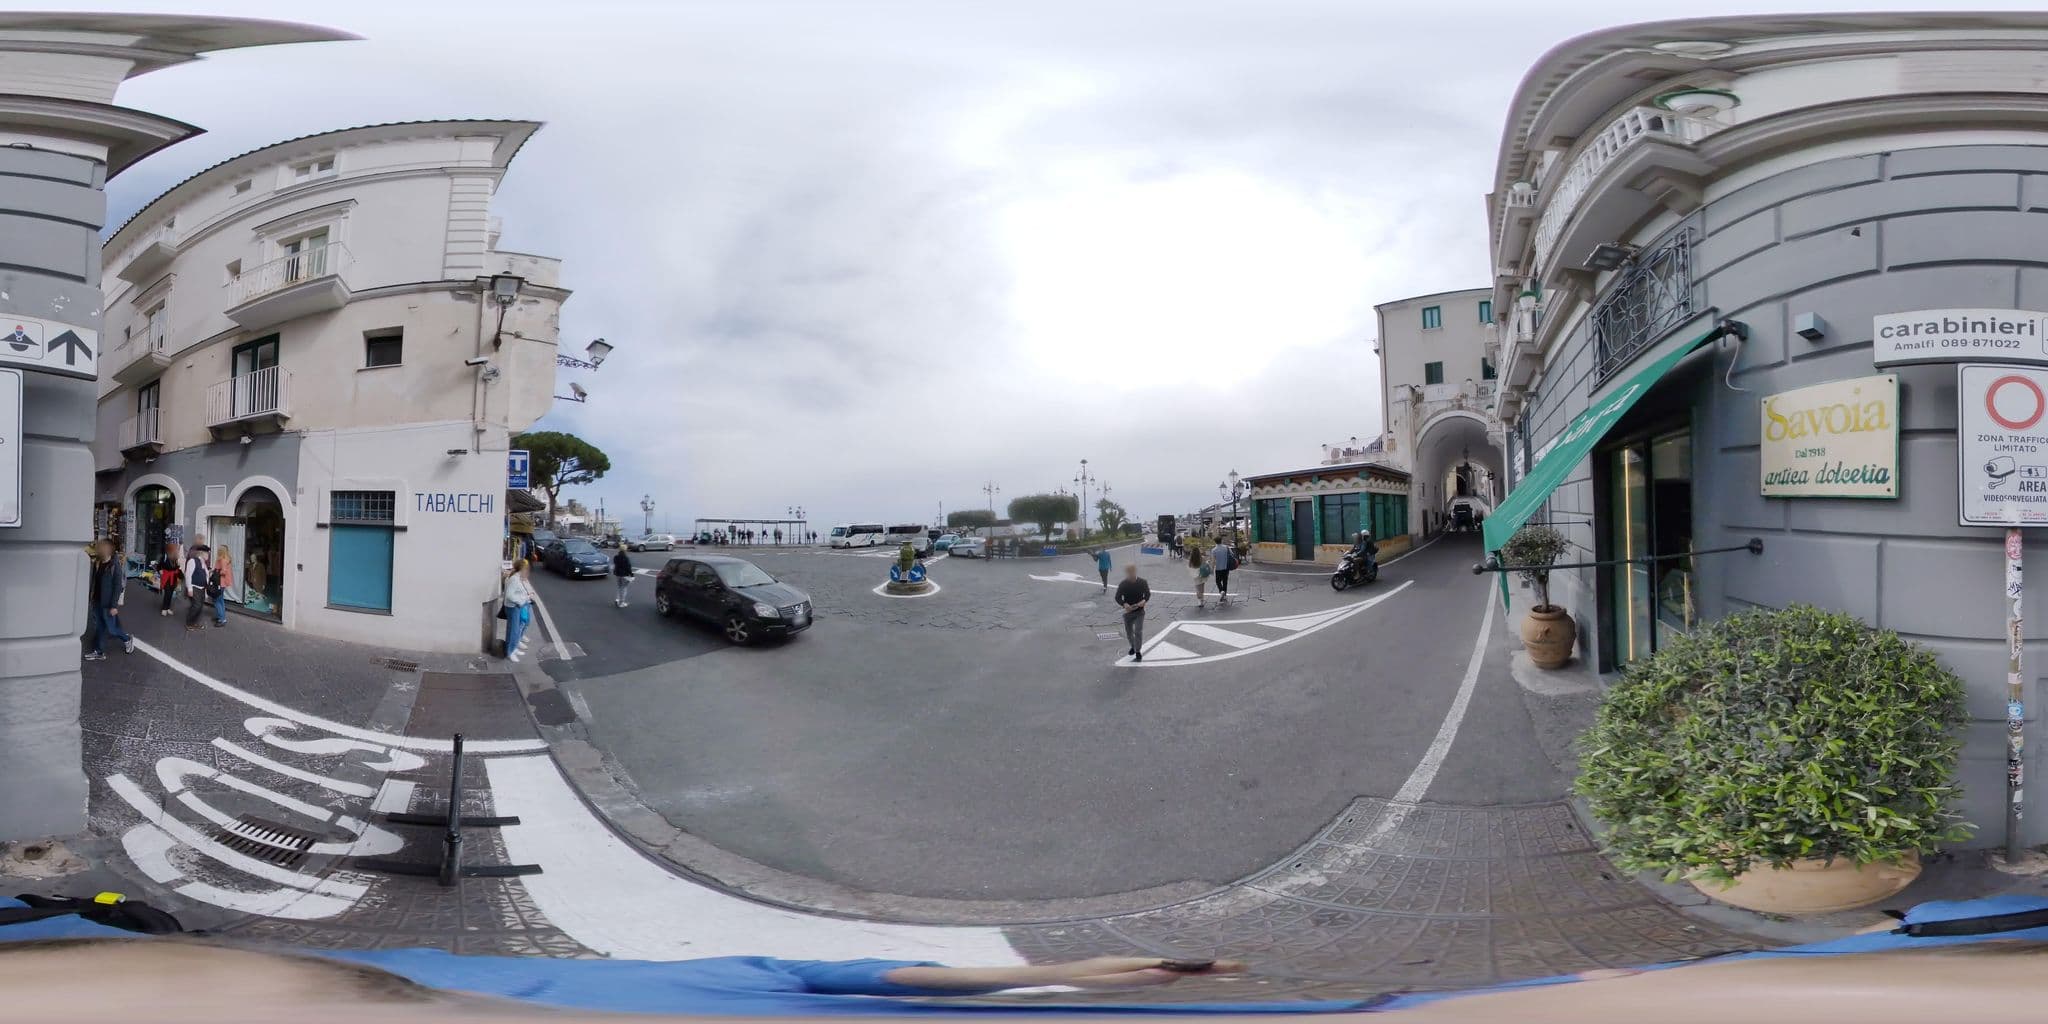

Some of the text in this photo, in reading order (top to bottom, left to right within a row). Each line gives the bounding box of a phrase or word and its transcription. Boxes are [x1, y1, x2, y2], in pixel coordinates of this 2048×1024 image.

[1880, 317, 2035, 339] carabinieri
[1894, 340, 1935, 351] Amalfi
[1766, 387, 1890, 442] Savoia
[1977, 434, 2004, 442] ZONA
[1795, 447, 1826, 459] Dal 1918
[1994, 444, 2037, 453] LIMITATO
[1765, 461, 1890, 485] antica dolceria
[2018, 480, 2047, 492] AREA
[415, 493, 494, 513] TABACCHI
